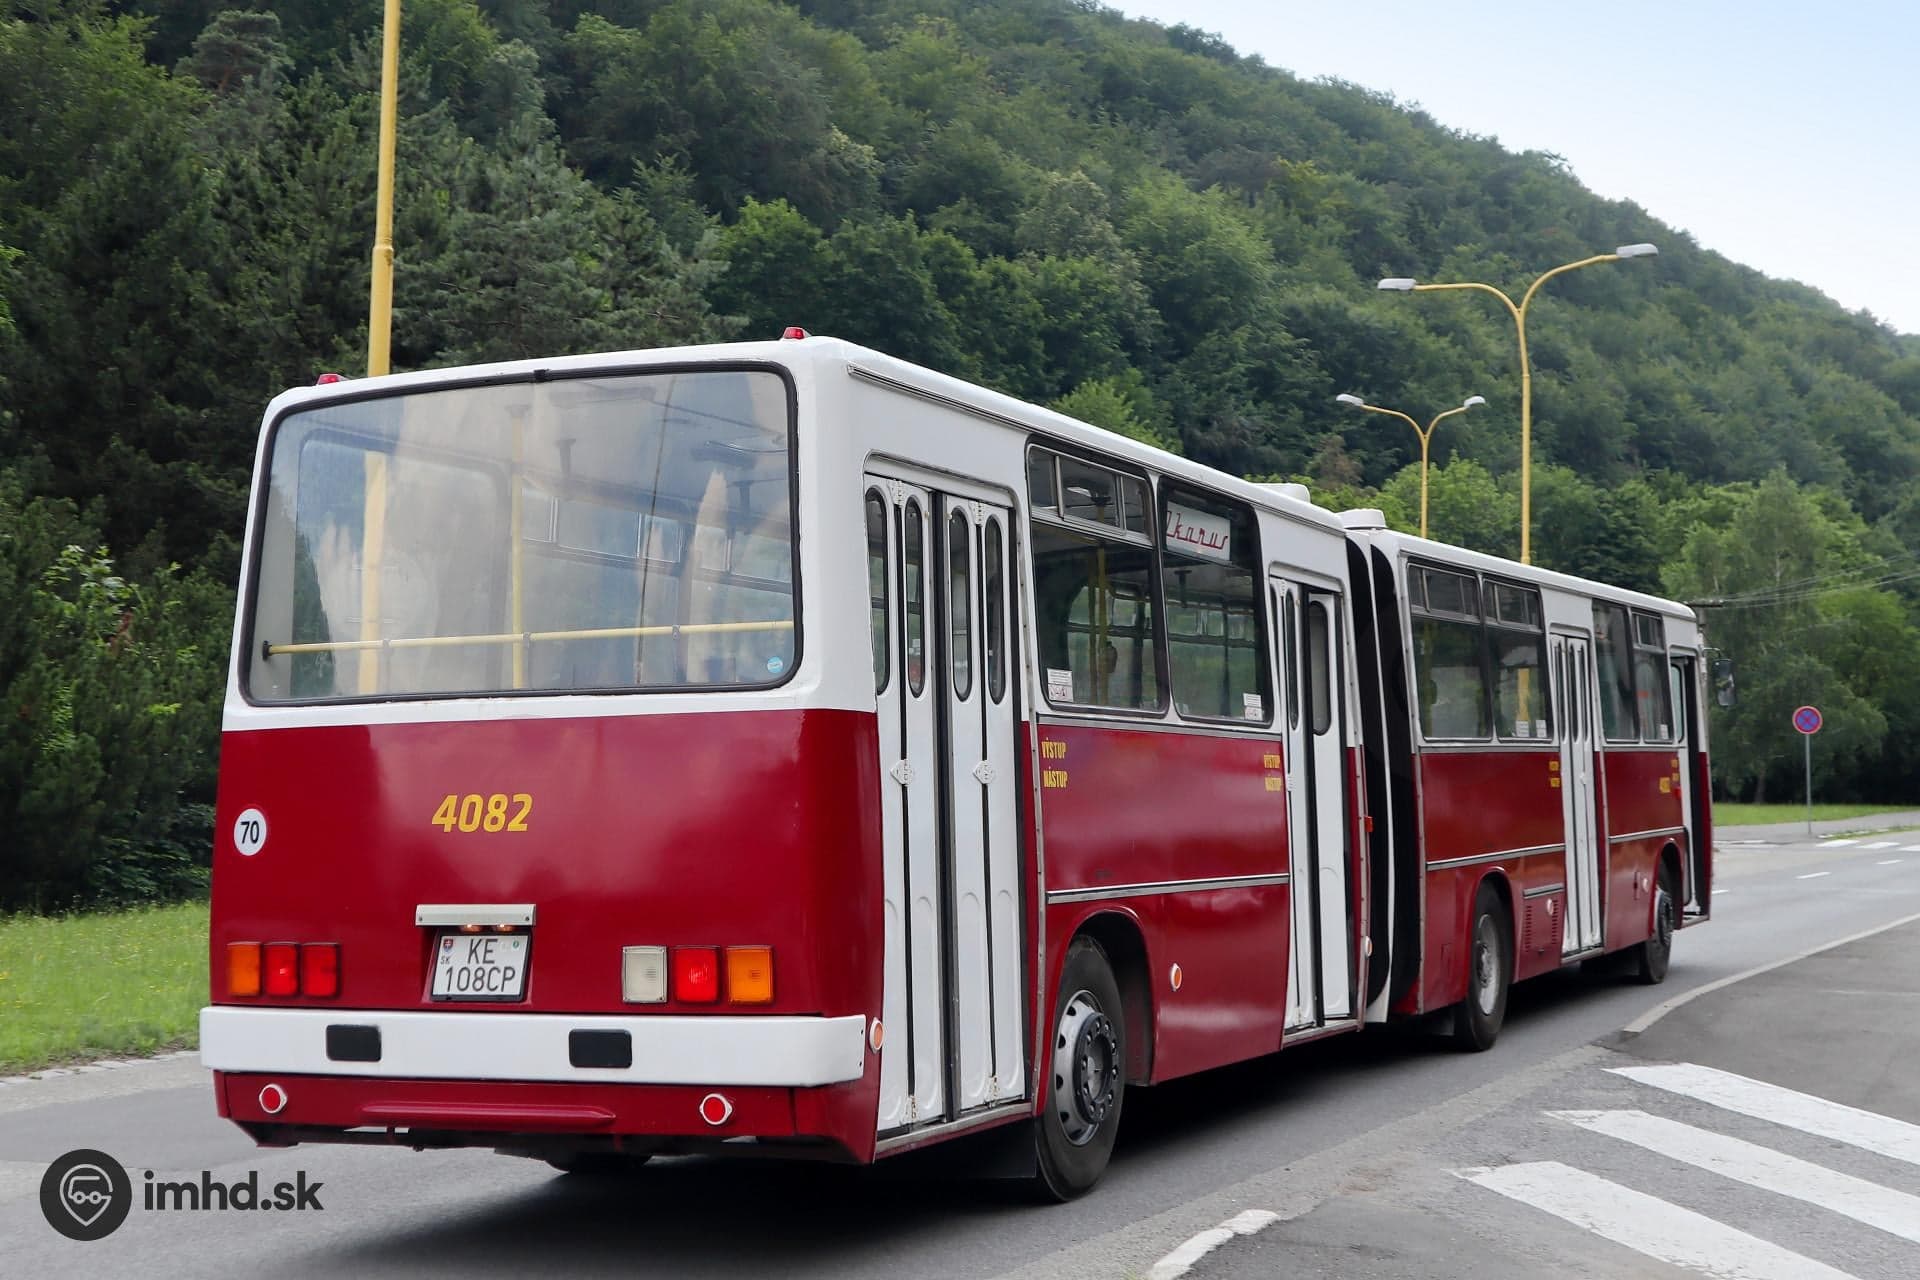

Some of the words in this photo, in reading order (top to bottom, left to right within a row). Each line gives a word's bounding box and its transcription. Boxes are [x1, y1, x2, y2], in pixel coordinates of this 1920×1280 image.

[1041, 736, 1067, 759] VÝSTUP
[431, 793, 534, 833] 4082
[240, 819, 260, 845] 70
[440, 956, 451, 965] SK
[467, 938, 499, 964] KE
[446, 966, 516, 993] 108CP
